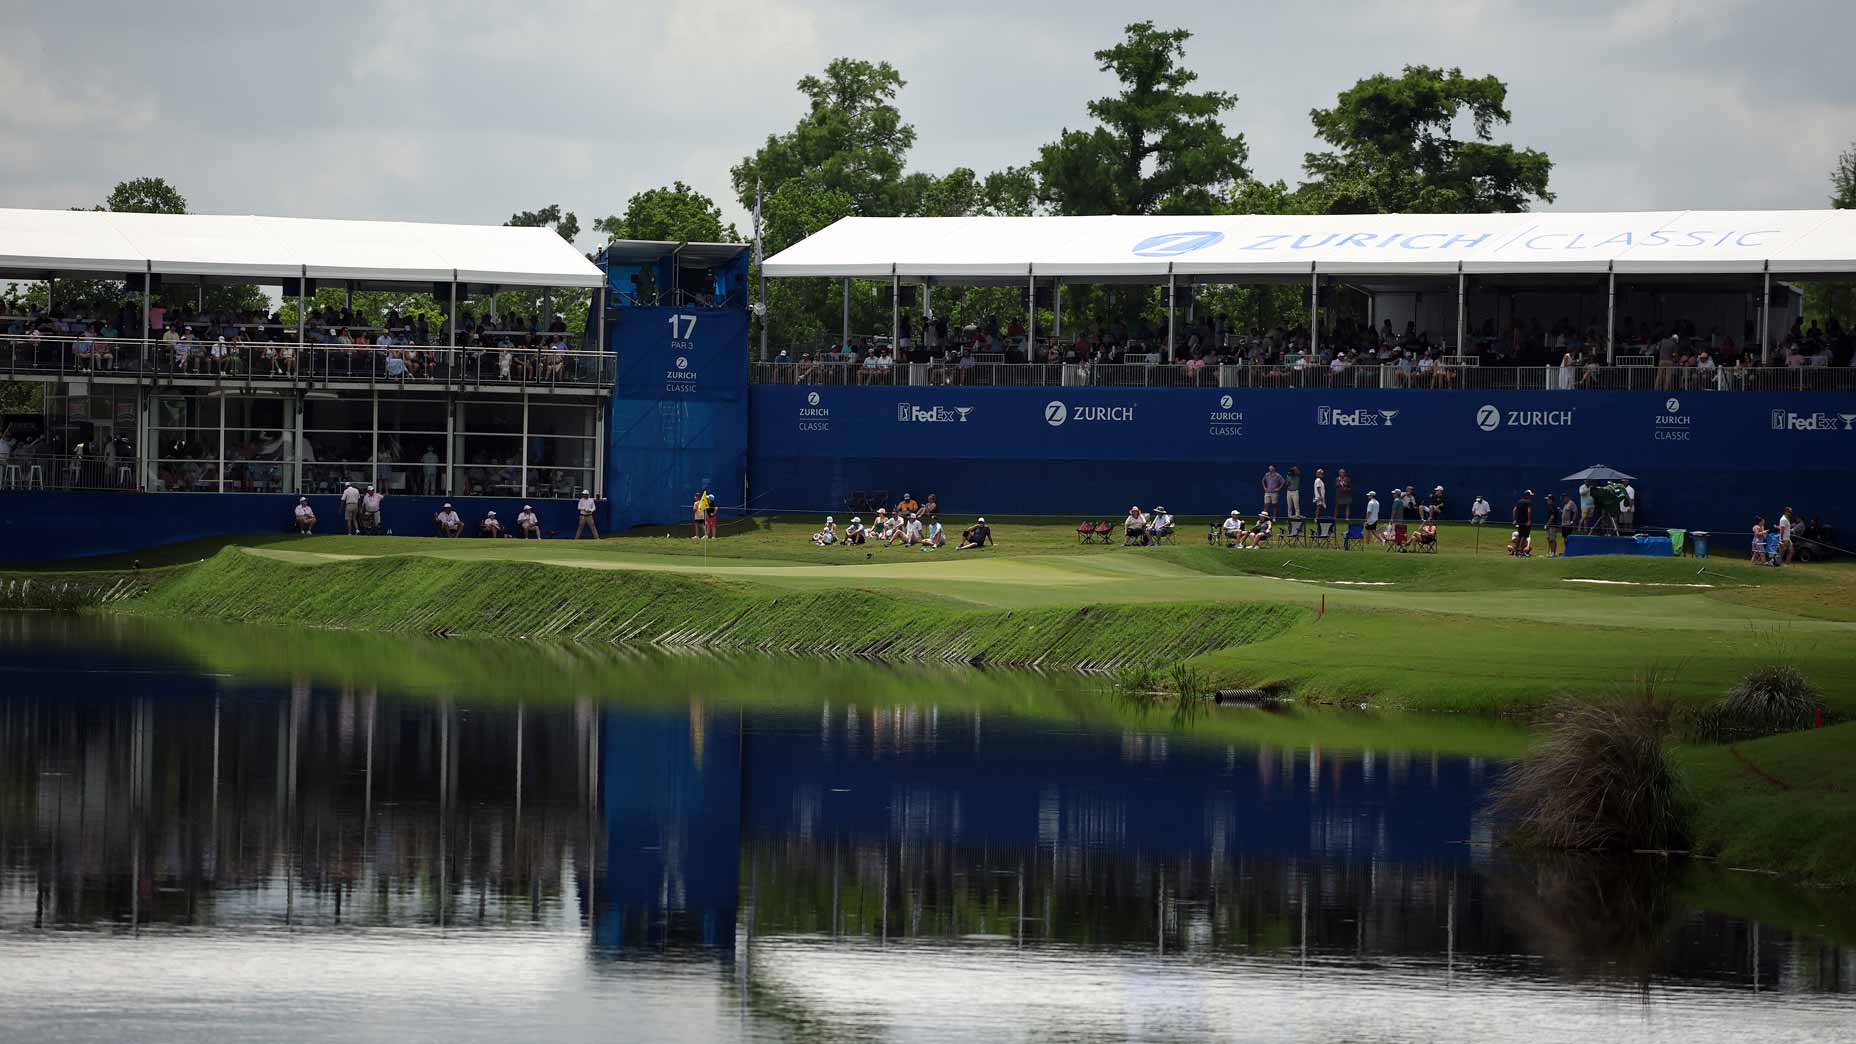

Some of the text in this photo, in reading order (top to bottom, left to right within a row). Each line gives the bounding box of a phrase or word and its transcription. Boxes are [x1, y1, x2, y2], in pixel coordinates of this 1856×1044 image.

[1132, 230, 1781, 257] Z ZURICH CLASSIC
[668, 314, 697, 340] 17
[671, 341, 694, 350] PAR 3
[666, 371, 697, 379] ZURICH
[666, 384, 697, 392] CLASSIC
[800, 408, 829, 416] ZURICH
[912, 406, 954, 422] FedEx
[1073, 406, 1134, 421] ZURICH
[1210, 412, 1243, 420] ZURICH
[1332, 409, 1378, 426] FedEx
[1508, 411, 1572, 426] ZURICH
[1656, 415, 1690, 424] ZURICH
[1788, 412, 1838, 430] FedEx
[799, 422, 829, 431] CLASSIC
[1209, 426, 1243, 436] CLASSIC
[1655, 431, 1690, 440] CLASSIC
